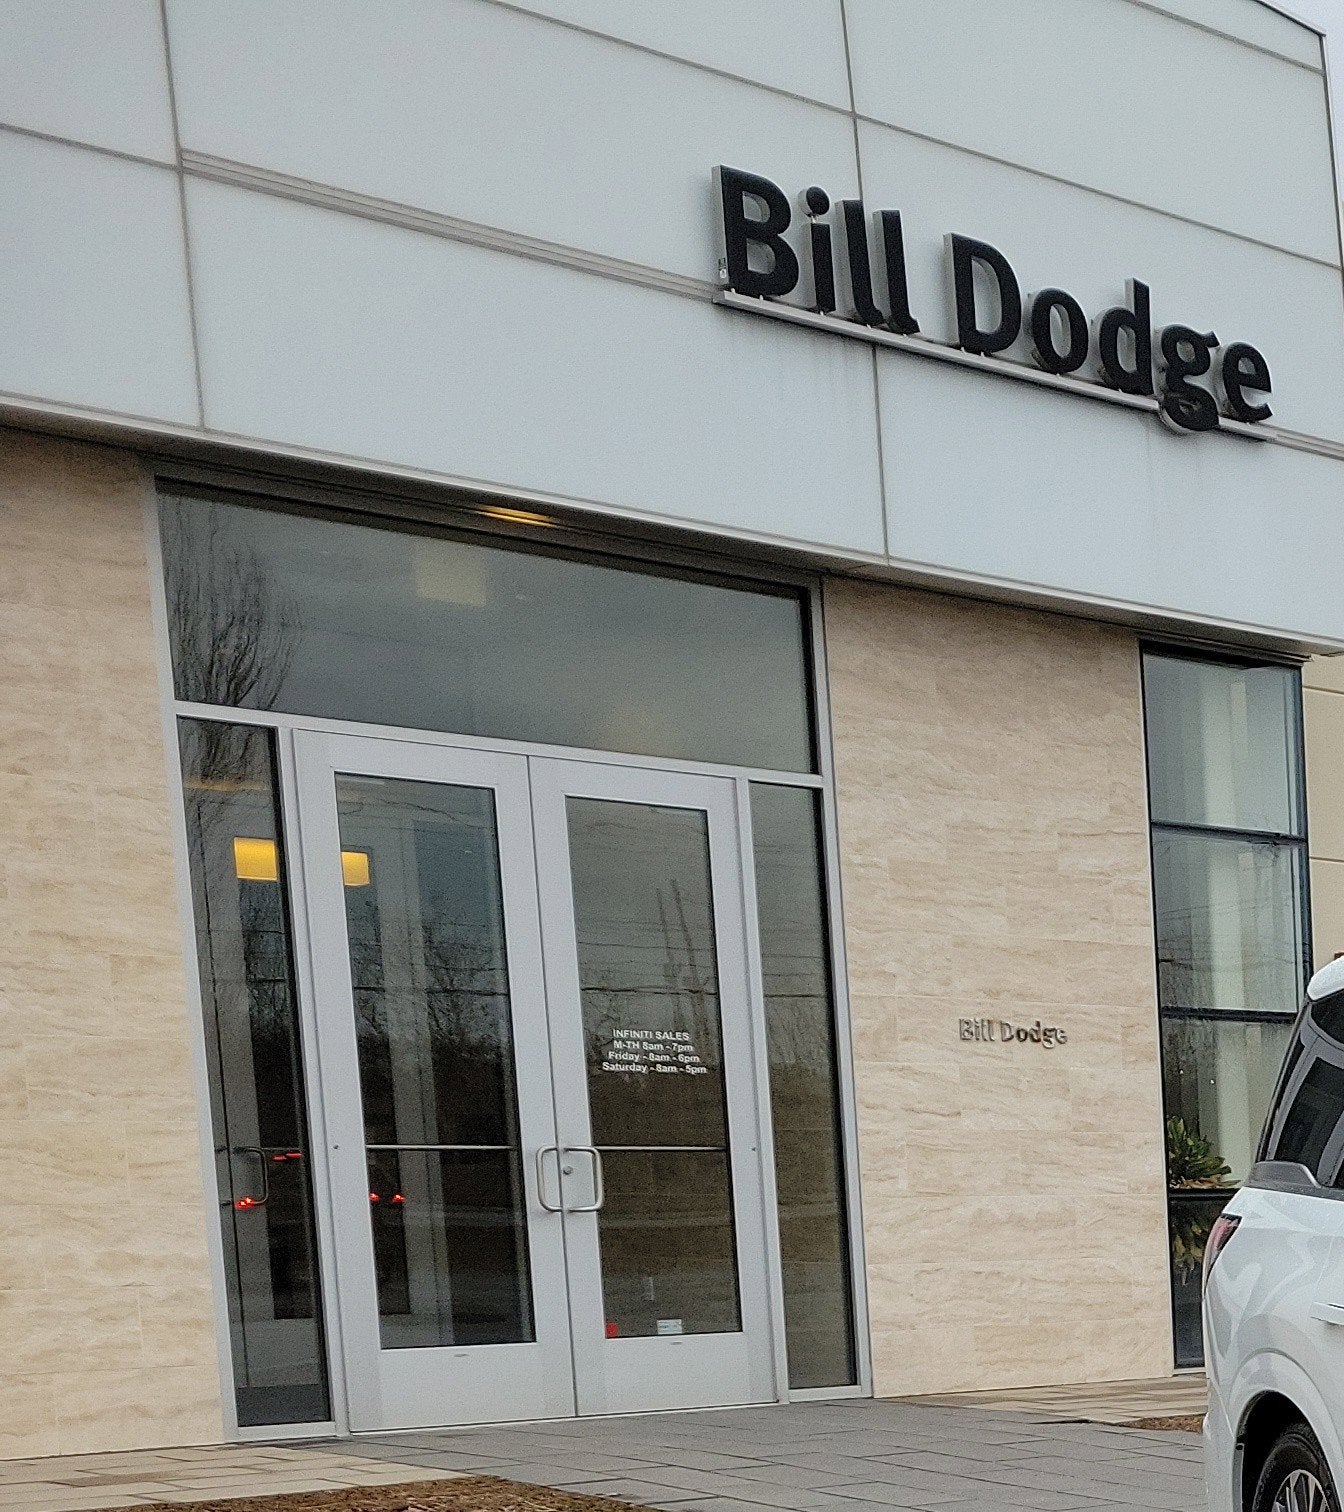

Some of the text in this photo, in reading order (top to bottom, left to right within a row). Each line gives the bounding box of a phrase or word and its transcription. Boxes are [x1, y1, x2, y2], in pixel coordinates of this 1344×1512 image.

[712, 164, 1273, 432] Bill Dodge
[613, 1029, 690, 1041] INFINITI SALES
[959, 1018, 1068, 1049] Bill Dodge
[613, 1040, 640, 1049] M-TH
[642, 1041, 665, 1051] 8am
[671, 1042, 694, 1052] 7pm
[608, 1051, 640, 1062] Friday
[602, 1061, 648, 1074] Saturday
